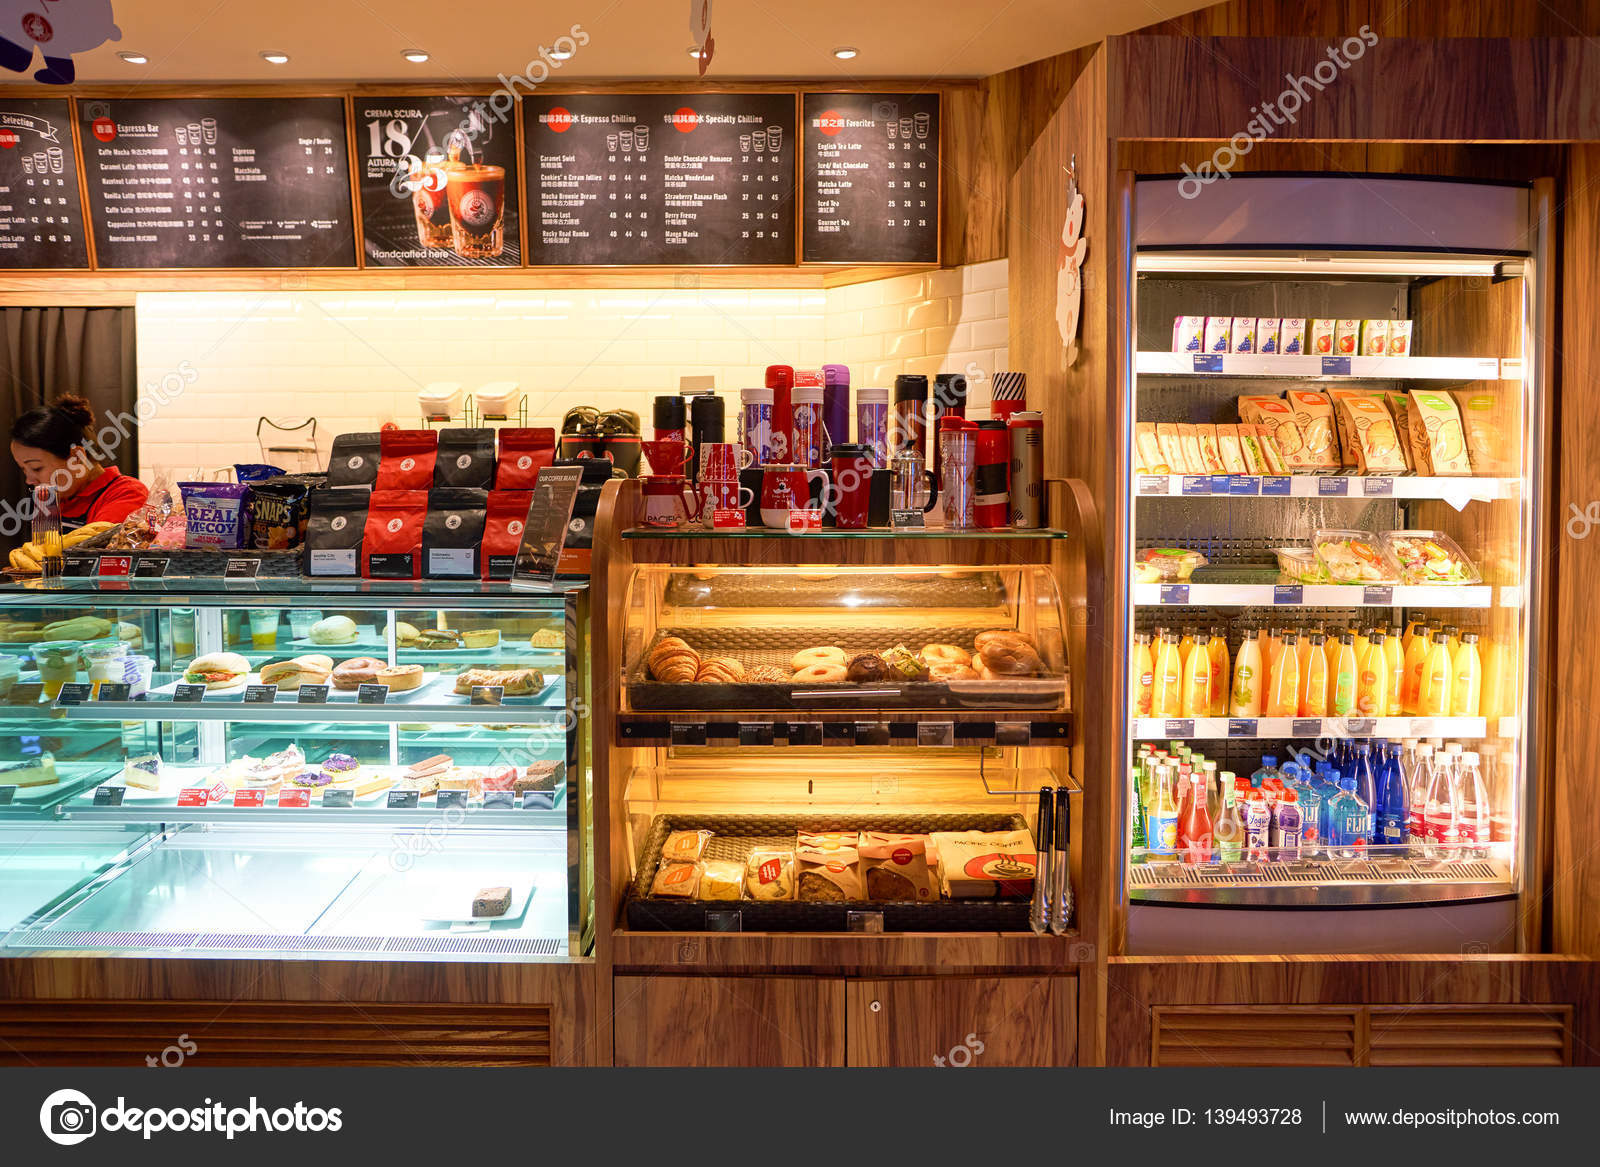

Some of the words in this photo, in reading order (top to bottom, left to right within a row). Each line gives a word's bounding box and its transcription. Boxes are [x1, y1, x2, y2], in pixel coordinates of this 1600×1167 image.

[365, 110, 393, 118] CREMA
[394, 110, 423, 118] SCURA
[581, 114, 609, 124] Espresso
[611, 114, 637, 123] Chilling
[706, 114, 736, 124] Specialty
[738, 115, 763, 123] Chilling
[846, 119, 875, 127] Favorites
[117, 124, 146, 134] Espresso
[147, 124, 159, 132] Bar
[368, 159, 396, 167] ALTURA
[665, 212, 679, 220] Berry
[680, 212, 697, 220] Frenzy
[542, 230, 558, 238] Rocky
[559, 230, 572, 238] Road
[373, 250, 426, 259] Handcrafted
[428, 250, 448, 258] here
[187, 507, 236, 523] REAL
[255, 500, 291, 523] SNAPS
[186, 521, 236, 534] McCOY
[1346, 816, 1366, 832] FIJI
[990, 840, 1024, 848] COFFEE
